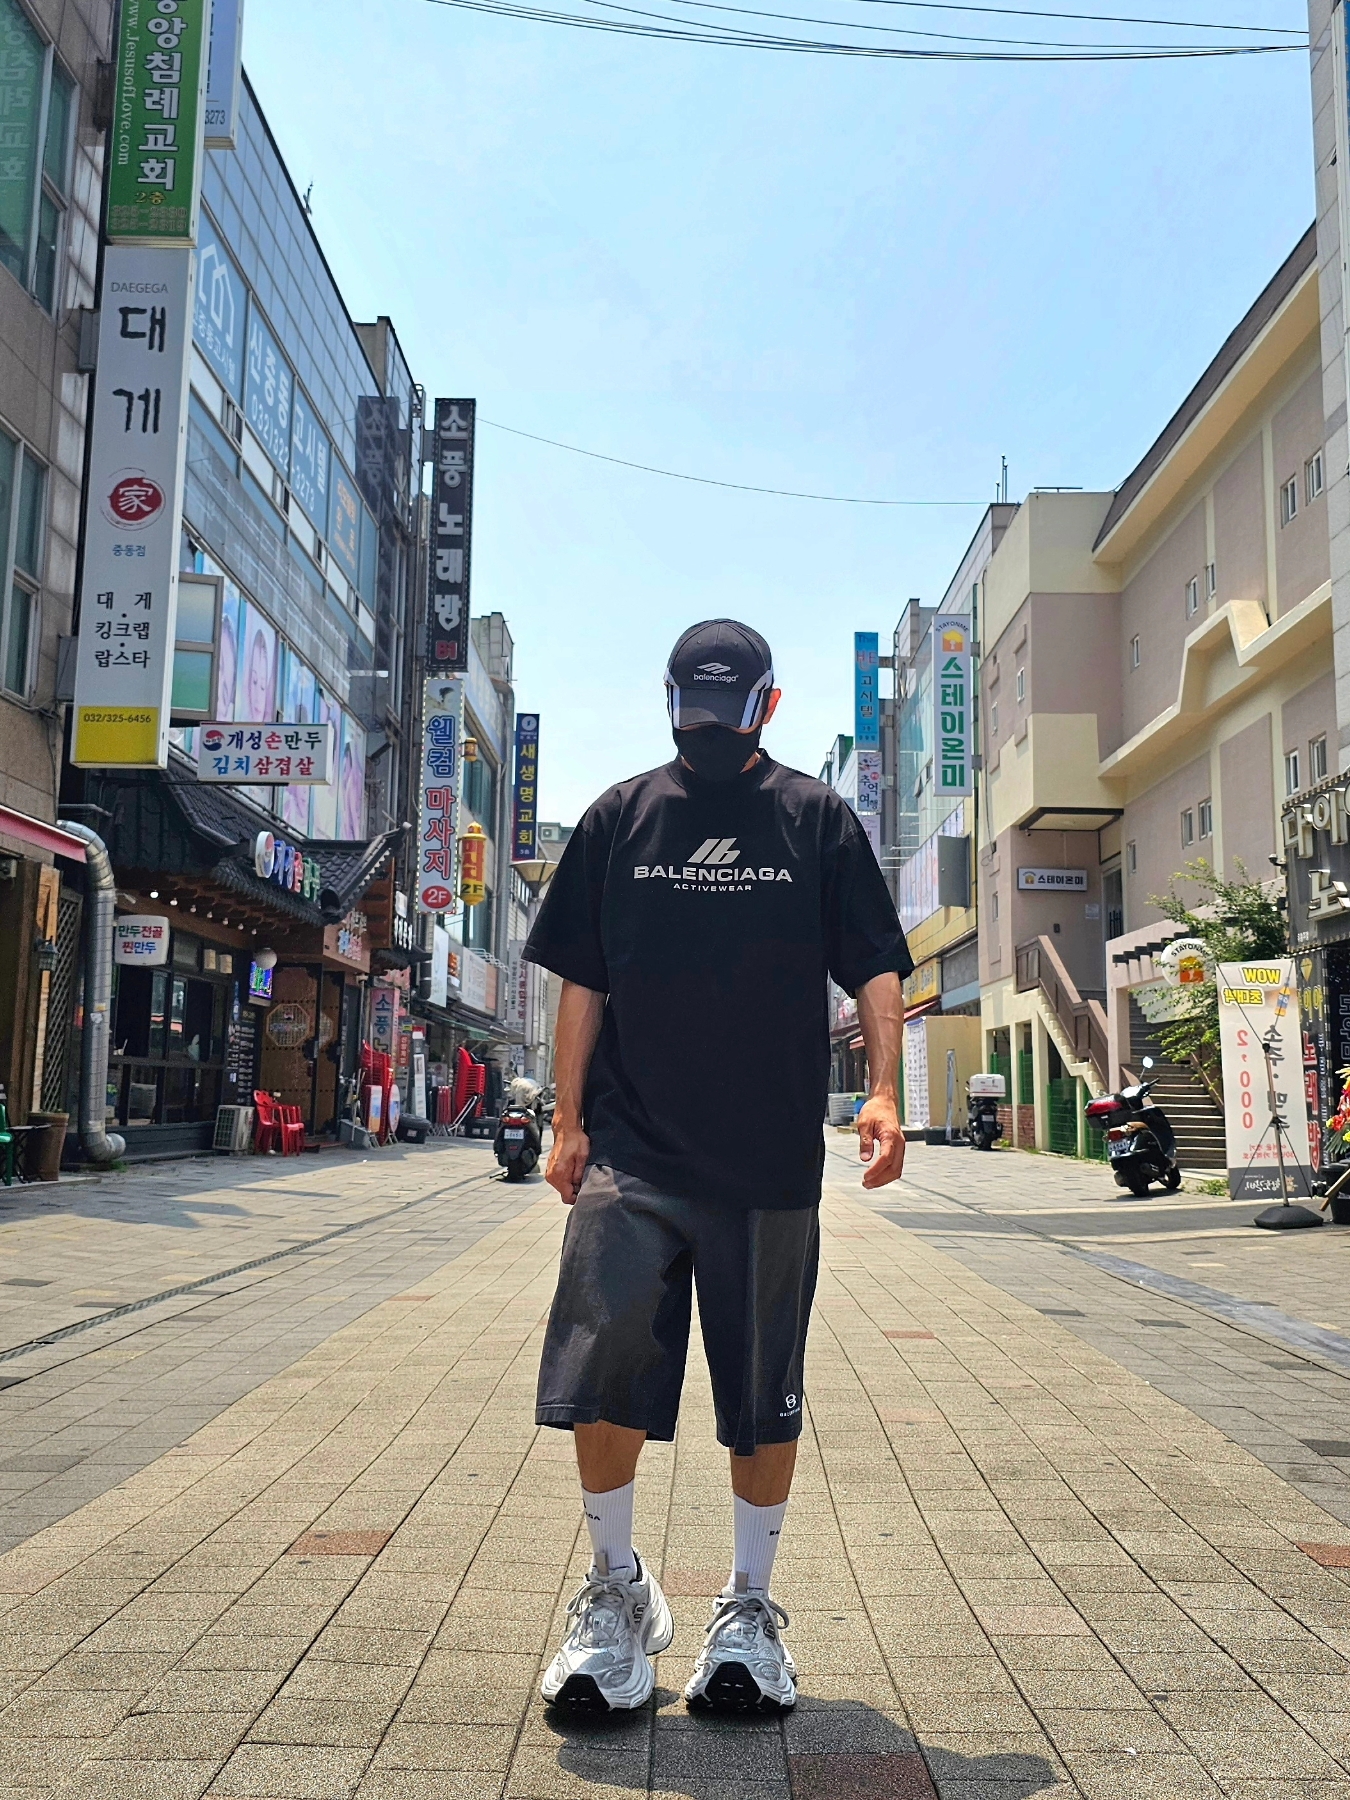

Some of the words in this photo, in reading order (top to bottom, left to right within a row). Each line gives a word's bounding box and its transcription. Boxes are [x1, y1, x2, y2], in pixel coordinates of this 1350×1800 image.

[110, 282, 169, 294] DAEGEGA
[439, 404, 469, 489] 소풍
[117, 484, 155, 515] 家
[112, 544, 146, 557] 중동점
[434, 502, 465, 632] 노래방
[94, 621, 150, 640] 킹크랩
[935, 621, 969, 633] STAYONME
[94, 650, 150, 669] 랍스타
[860, 675, 874, 718] 고시텔
[83, 713, 151, 724] 032/325-6456
[940, 656, 965, 788] 스테이온미
[226, 729, 322, 751] 개성손만두
[427, 715, 456, 778] 웰컴
[517, 743, 536, 846] 새생명교회
[424, 784, 456, 880] 마사지
[633, 865, 793, 883] BALENCIAGA
[1037, 874, 1084, 885] 스테이온미
[427, 888, 447, 904] 2F
[461, 883, 483, 894] 2F
[673, 883, 752, 892] ACTIVEWEAR
[117, 925, 164, 939] 만두전골
[121, 941, 157, 954] 찐만두
